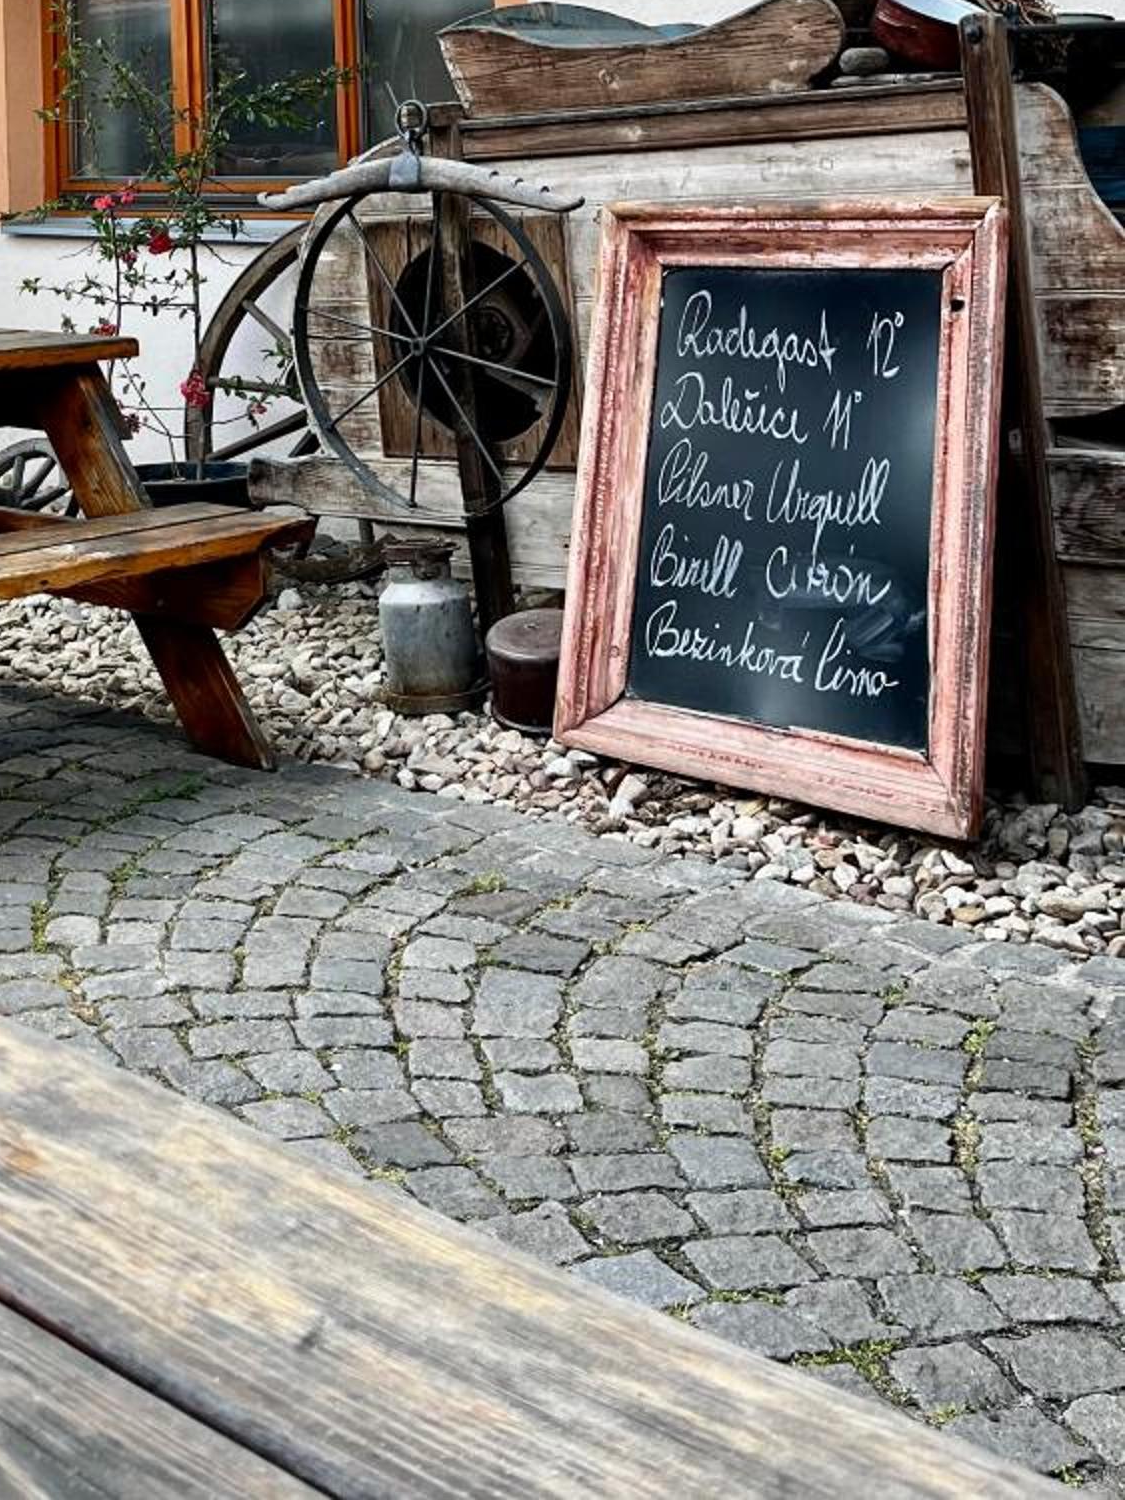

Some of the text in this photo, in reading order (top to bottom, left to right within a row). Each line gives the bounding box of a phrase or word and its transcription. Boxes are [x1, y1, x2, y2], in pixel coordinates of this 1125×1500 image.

[677, 289, 837, 393] Radegast
[658, 437, 891, 568] Pilsner Urquell
[650, 523, 744, 599] Birell
